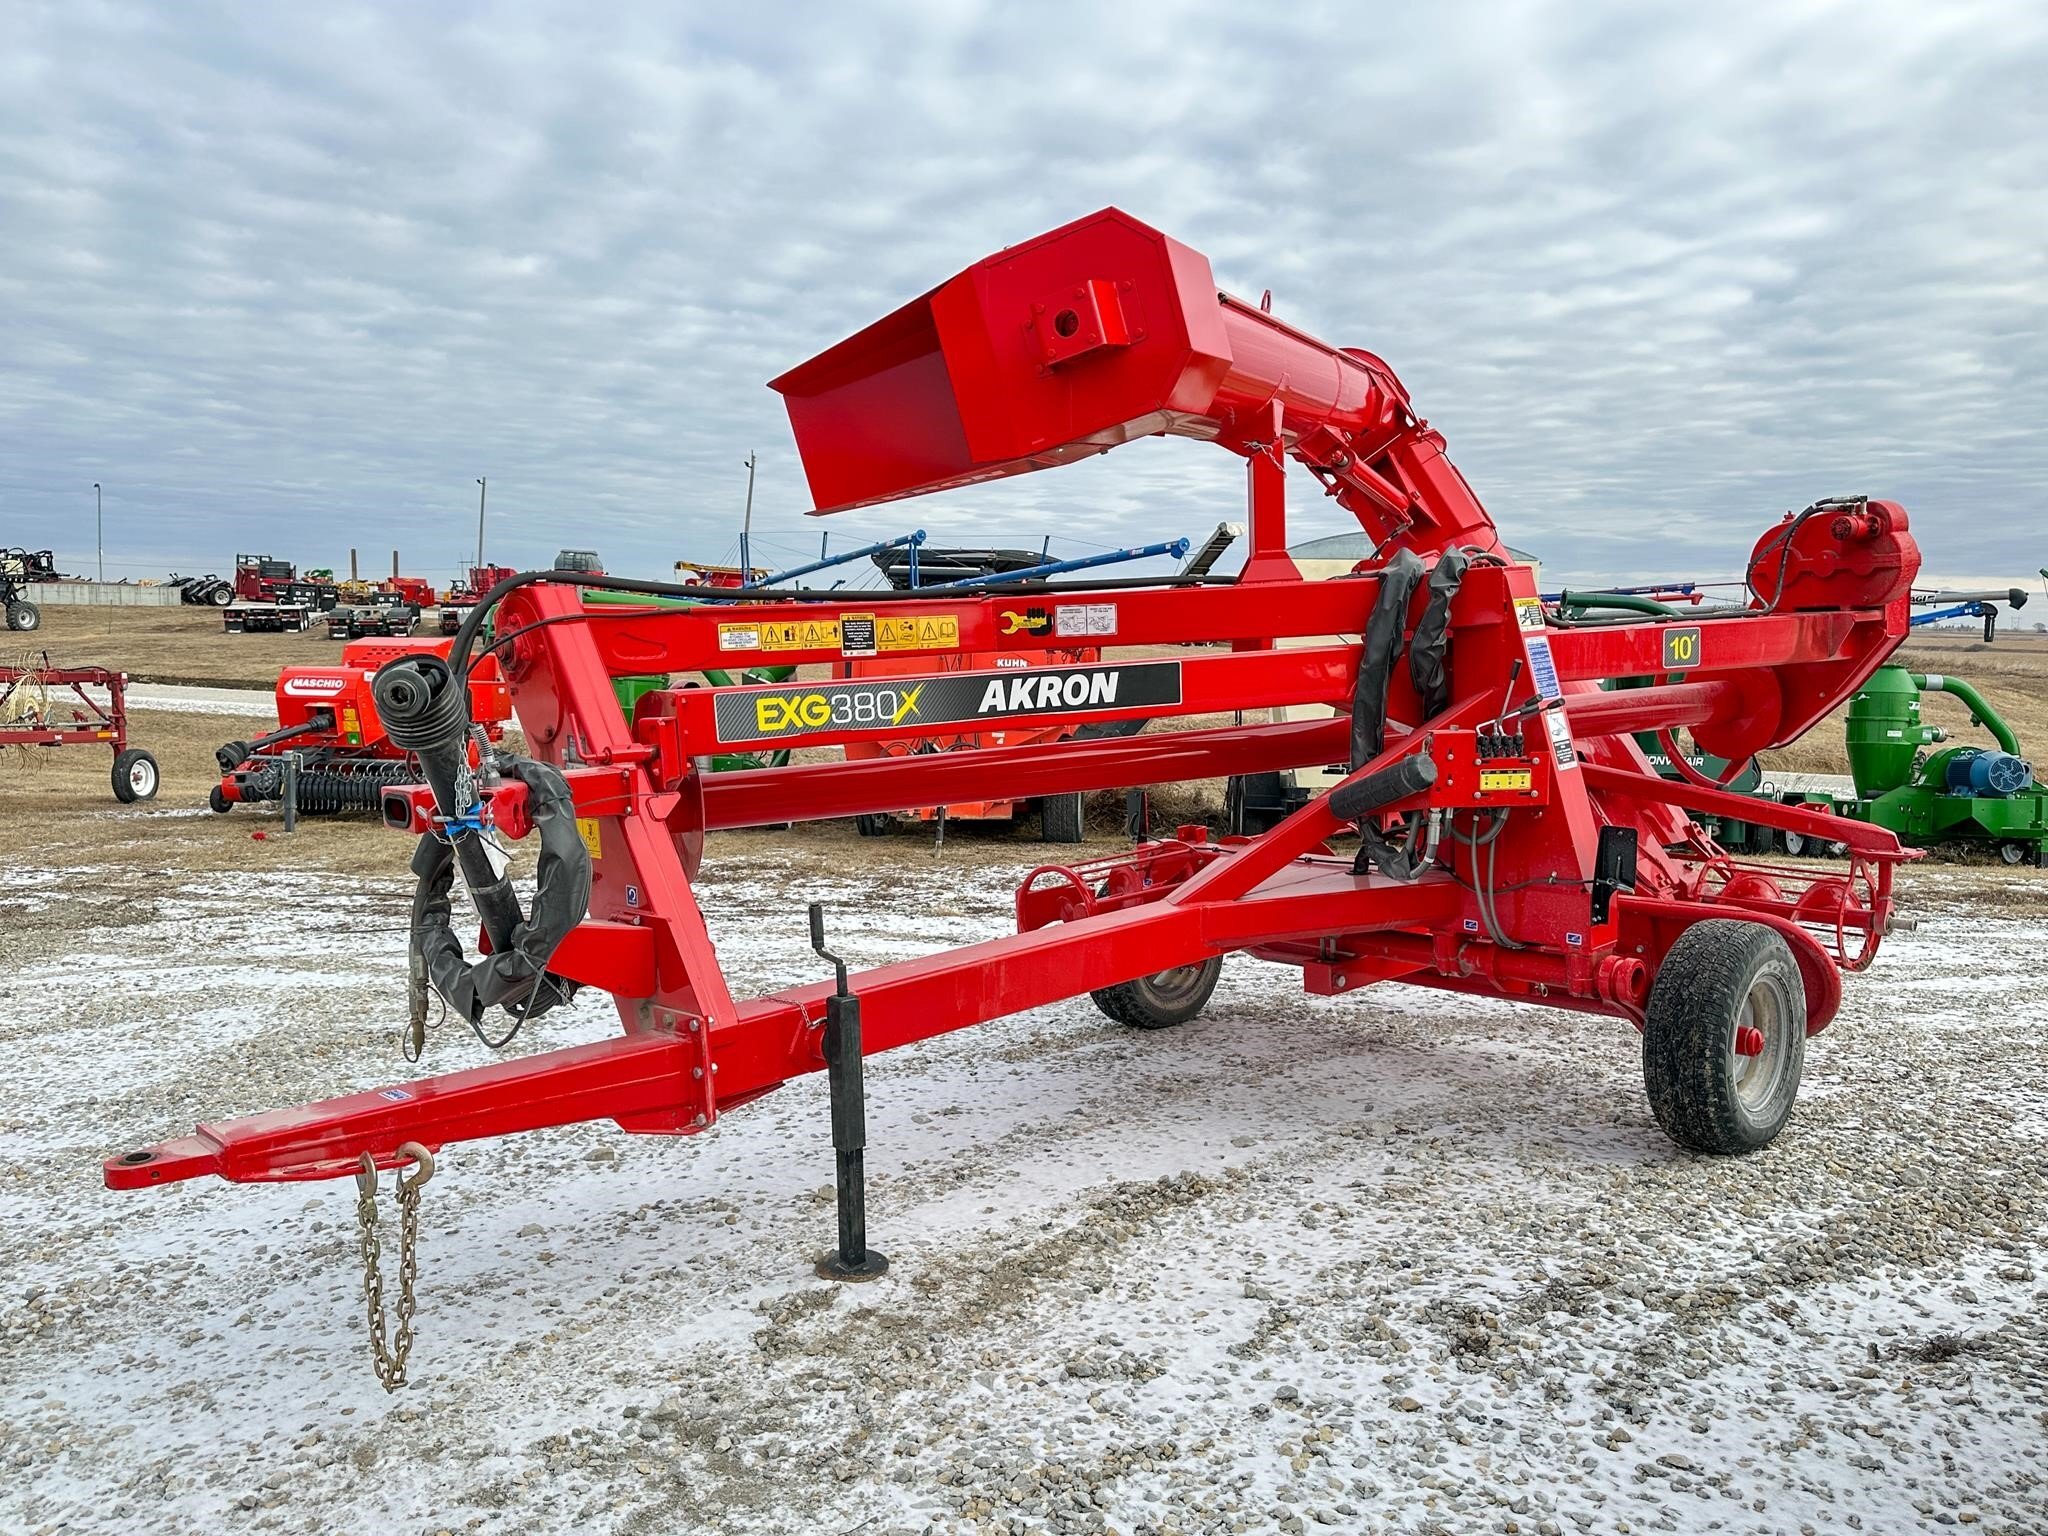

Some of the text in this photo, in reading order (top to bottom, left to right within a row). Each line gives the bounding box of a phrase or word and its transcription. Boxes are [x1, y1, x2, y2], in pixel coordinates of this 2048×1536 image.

[997, 658, 1027, 668] KUHN
[292, 678, 344, 688] MASCHIO
[977, 671, 1119, 713] AKRON
[756, 682, 926, 731] EXG380X
